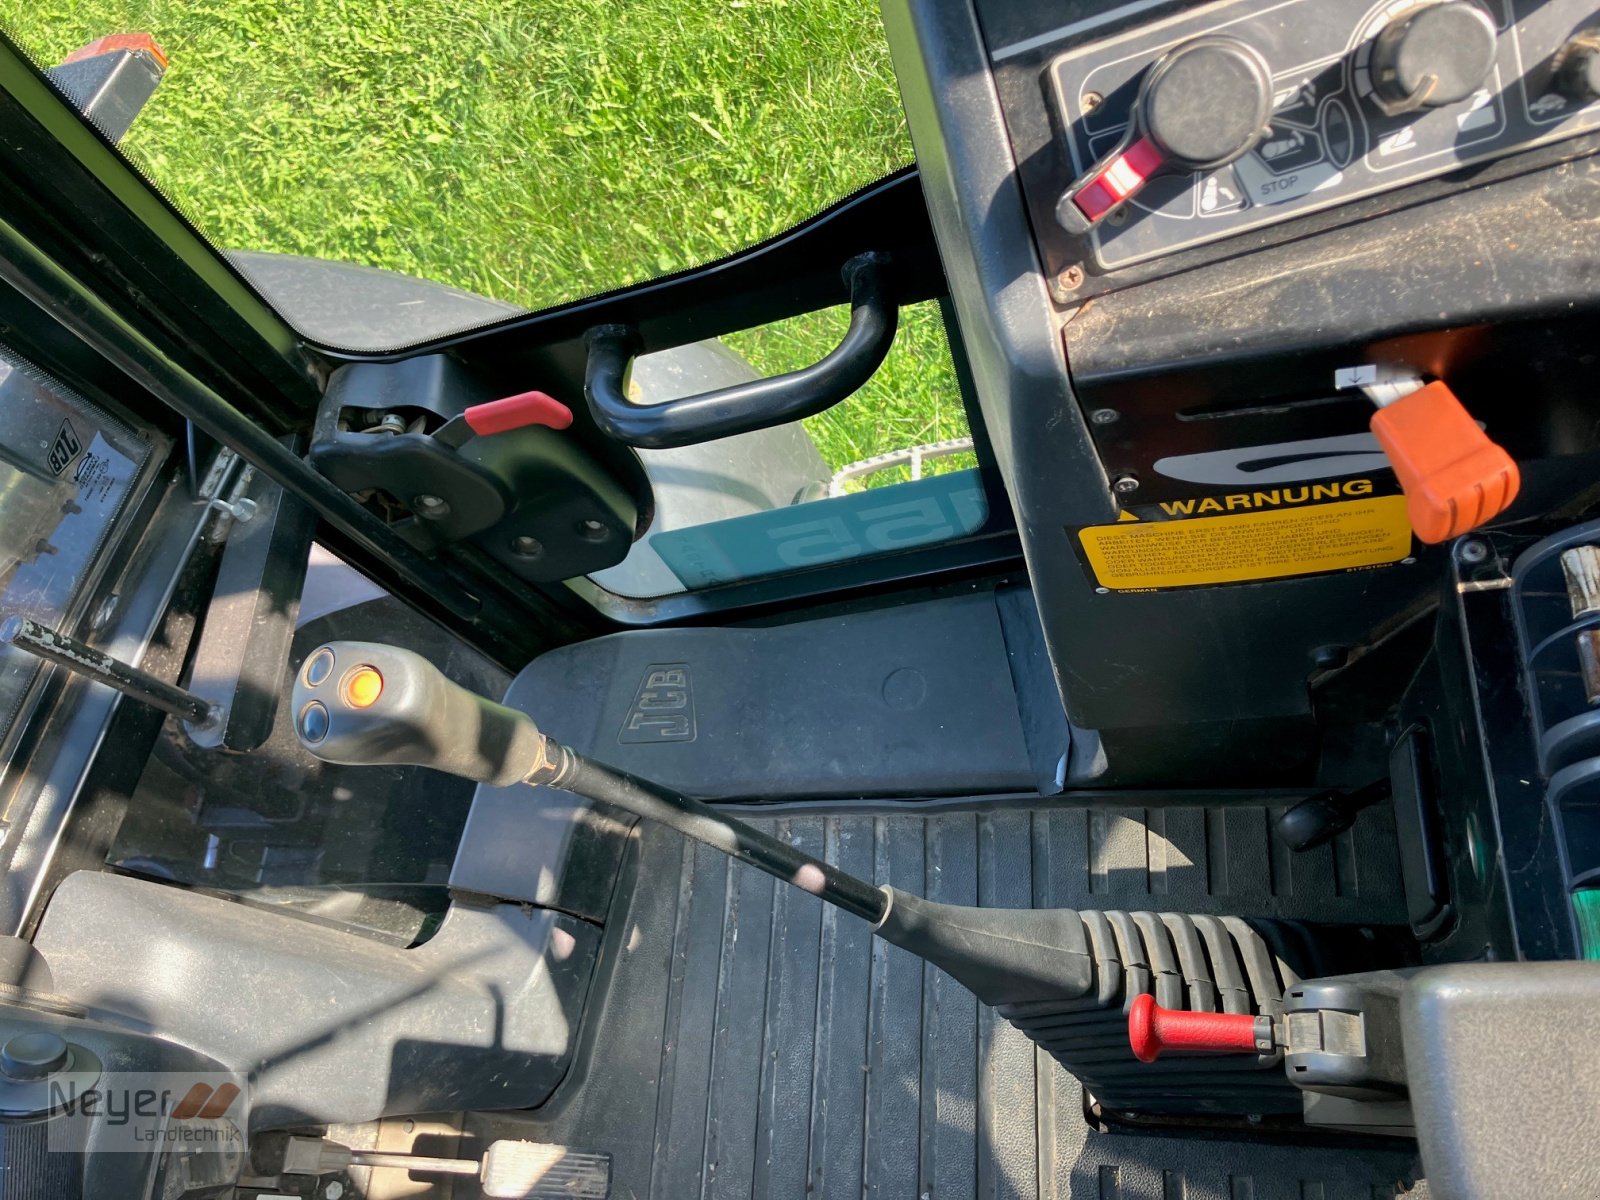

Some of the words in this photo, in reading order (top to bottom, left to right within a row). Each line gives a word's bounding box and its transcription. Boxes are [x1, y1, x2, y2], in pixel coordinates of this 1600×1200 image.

[1261, 175, 1298, 195] STOP
[1160, 480, 1373, 516] WARNUNG
[628, 669, 690, 737] JCB
